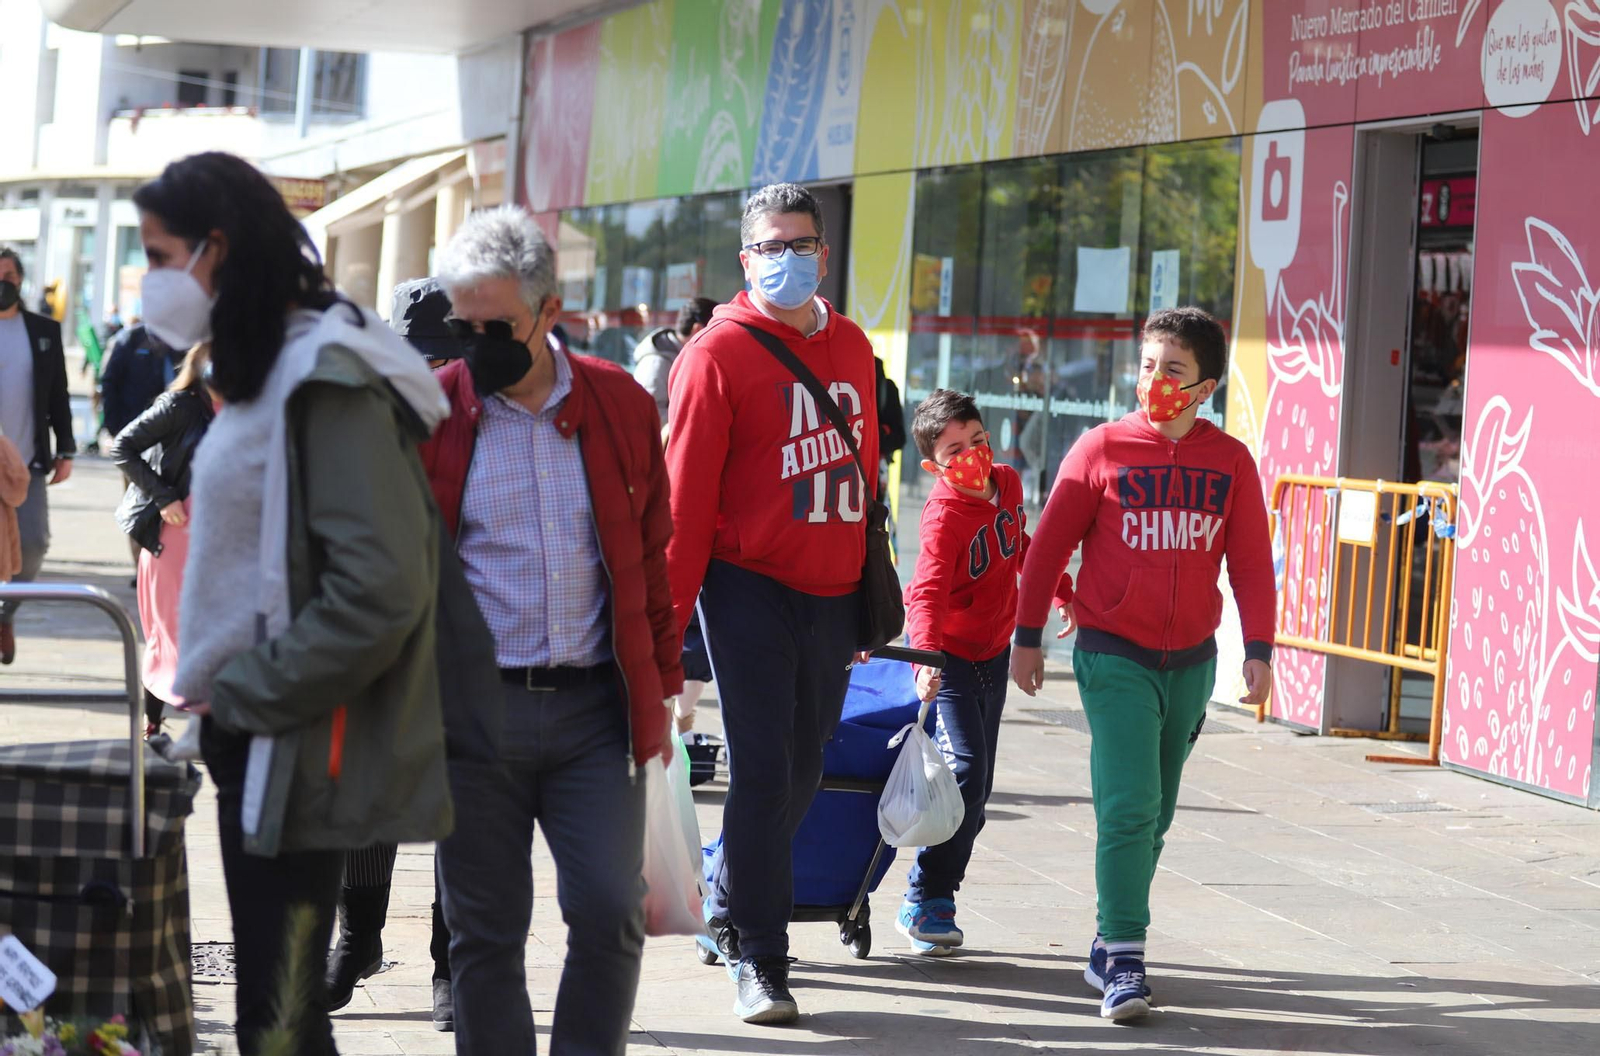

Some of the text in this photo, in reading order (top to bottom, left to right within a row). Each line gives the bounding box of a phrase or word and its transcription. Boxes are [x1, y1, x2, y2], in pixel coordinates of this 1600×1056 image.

[1291, 0, 1457, 41] Nuevo Mercado del Carmen
[1488, 28, 1503, 56] Que
[1506, 35, 1516, 50] me
[1532, 19, 1557, 61] quitan
[1368, 25, 1441, 89] imprescindible
[1497, 56, 1507, 85] de
[1127, 468, 1222, 512] STATE
